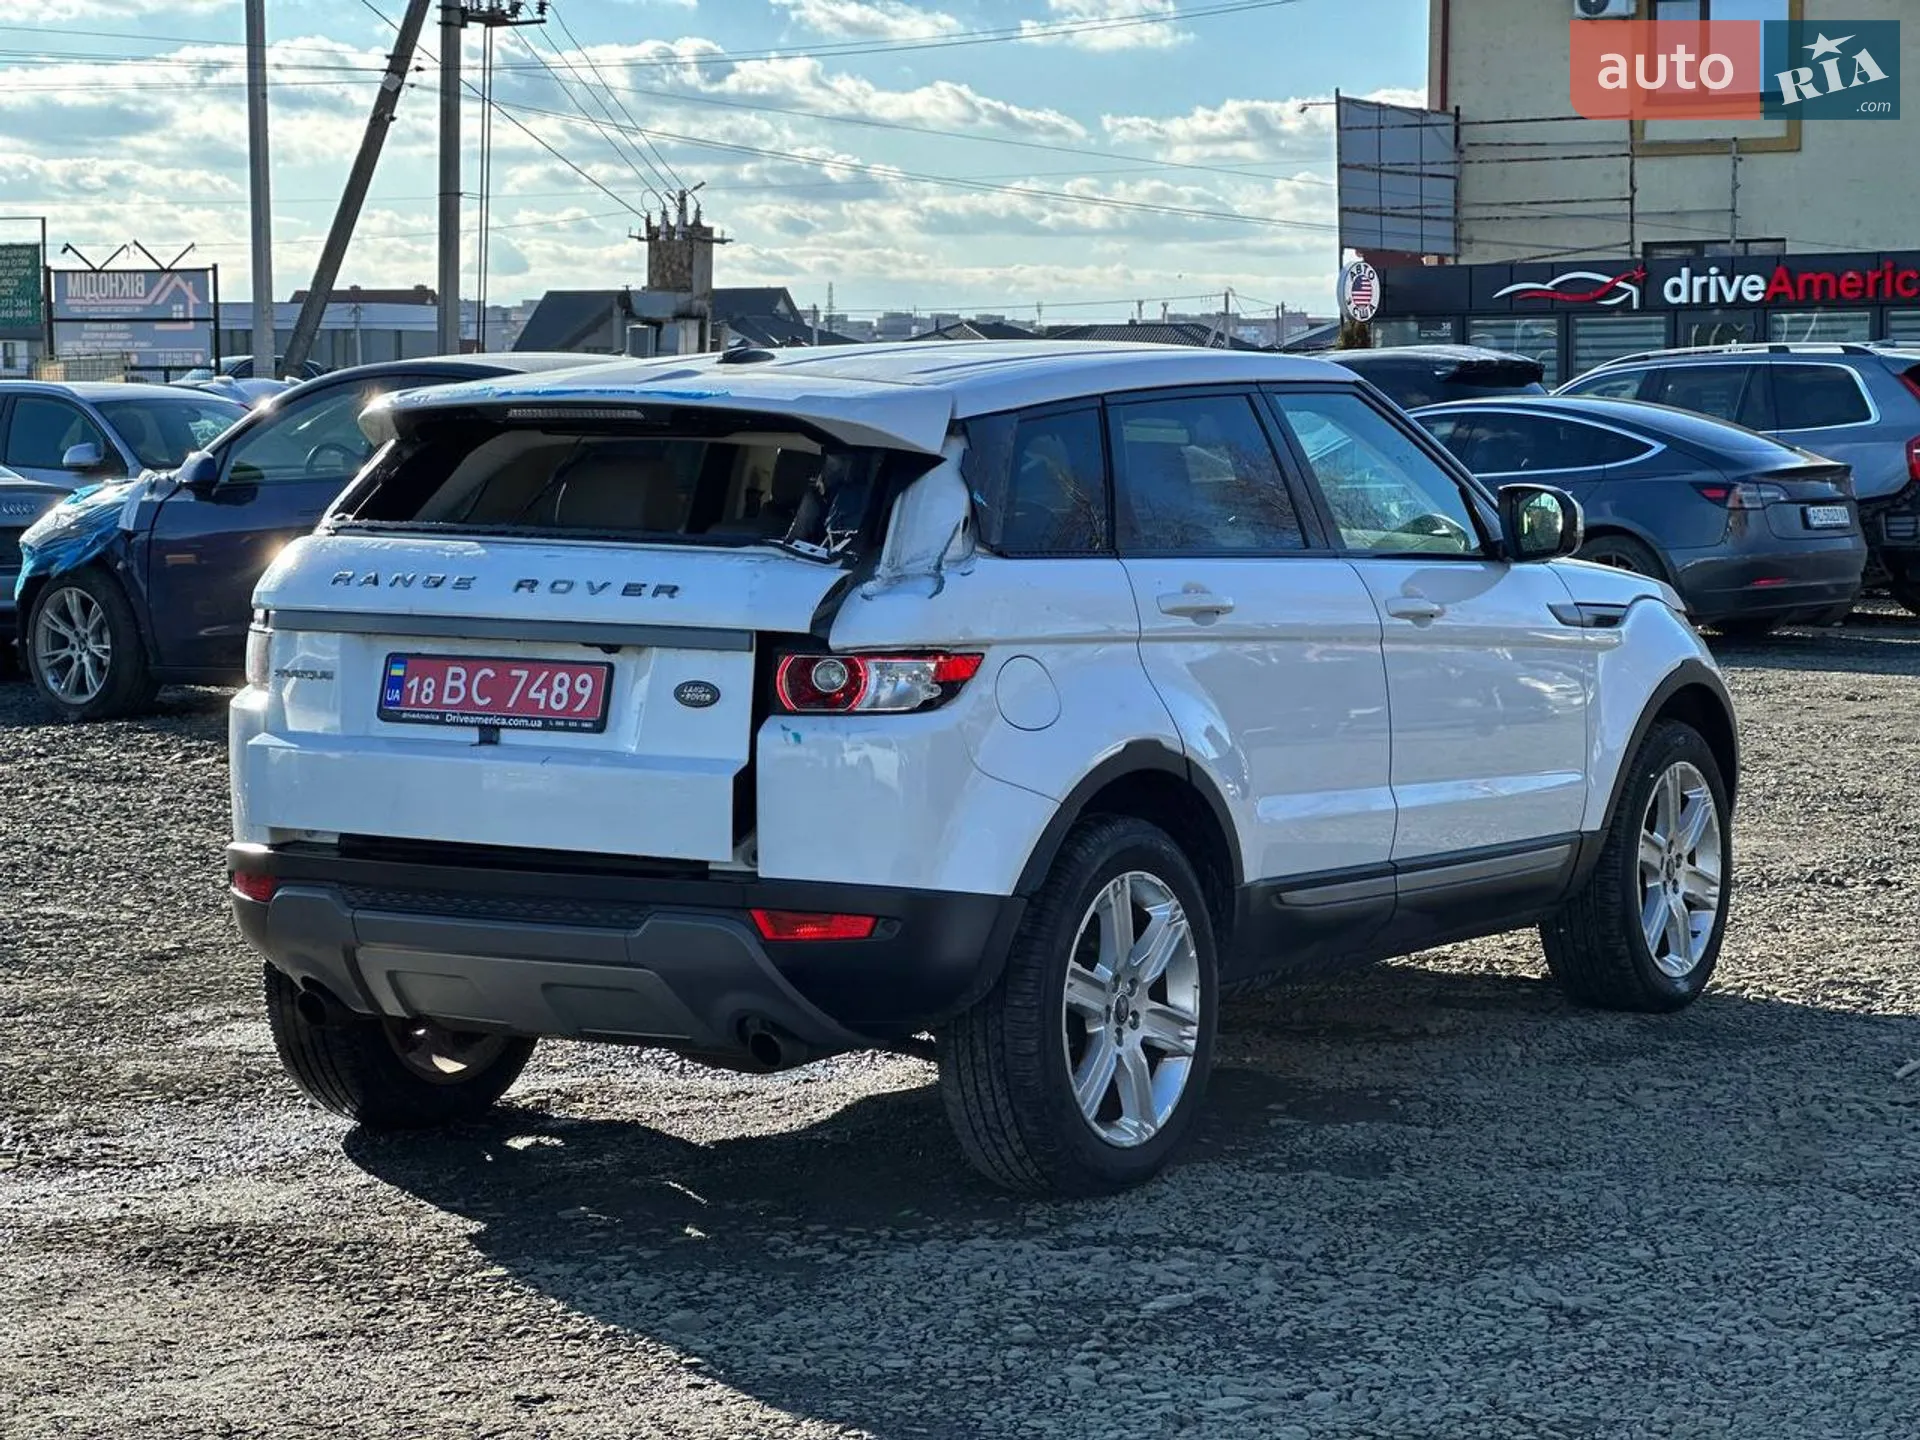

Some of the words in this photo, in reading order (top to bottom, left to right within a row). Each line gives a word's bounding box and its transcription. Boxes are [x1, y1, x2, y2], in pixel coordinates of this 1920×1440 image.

[1350, 264, 1376, 281] АВТО
[331, 570, 477, 591] RANGE
[512, 578, 681, 599] ROVER
[386, 688, 401, 701] UA
[406, 676, 436, 705] 18
[442, 666, 496, 706] BC
[506, 669, 593, 712] 7489
[445, 713, 543, 728] Driveamerica.com.ua
